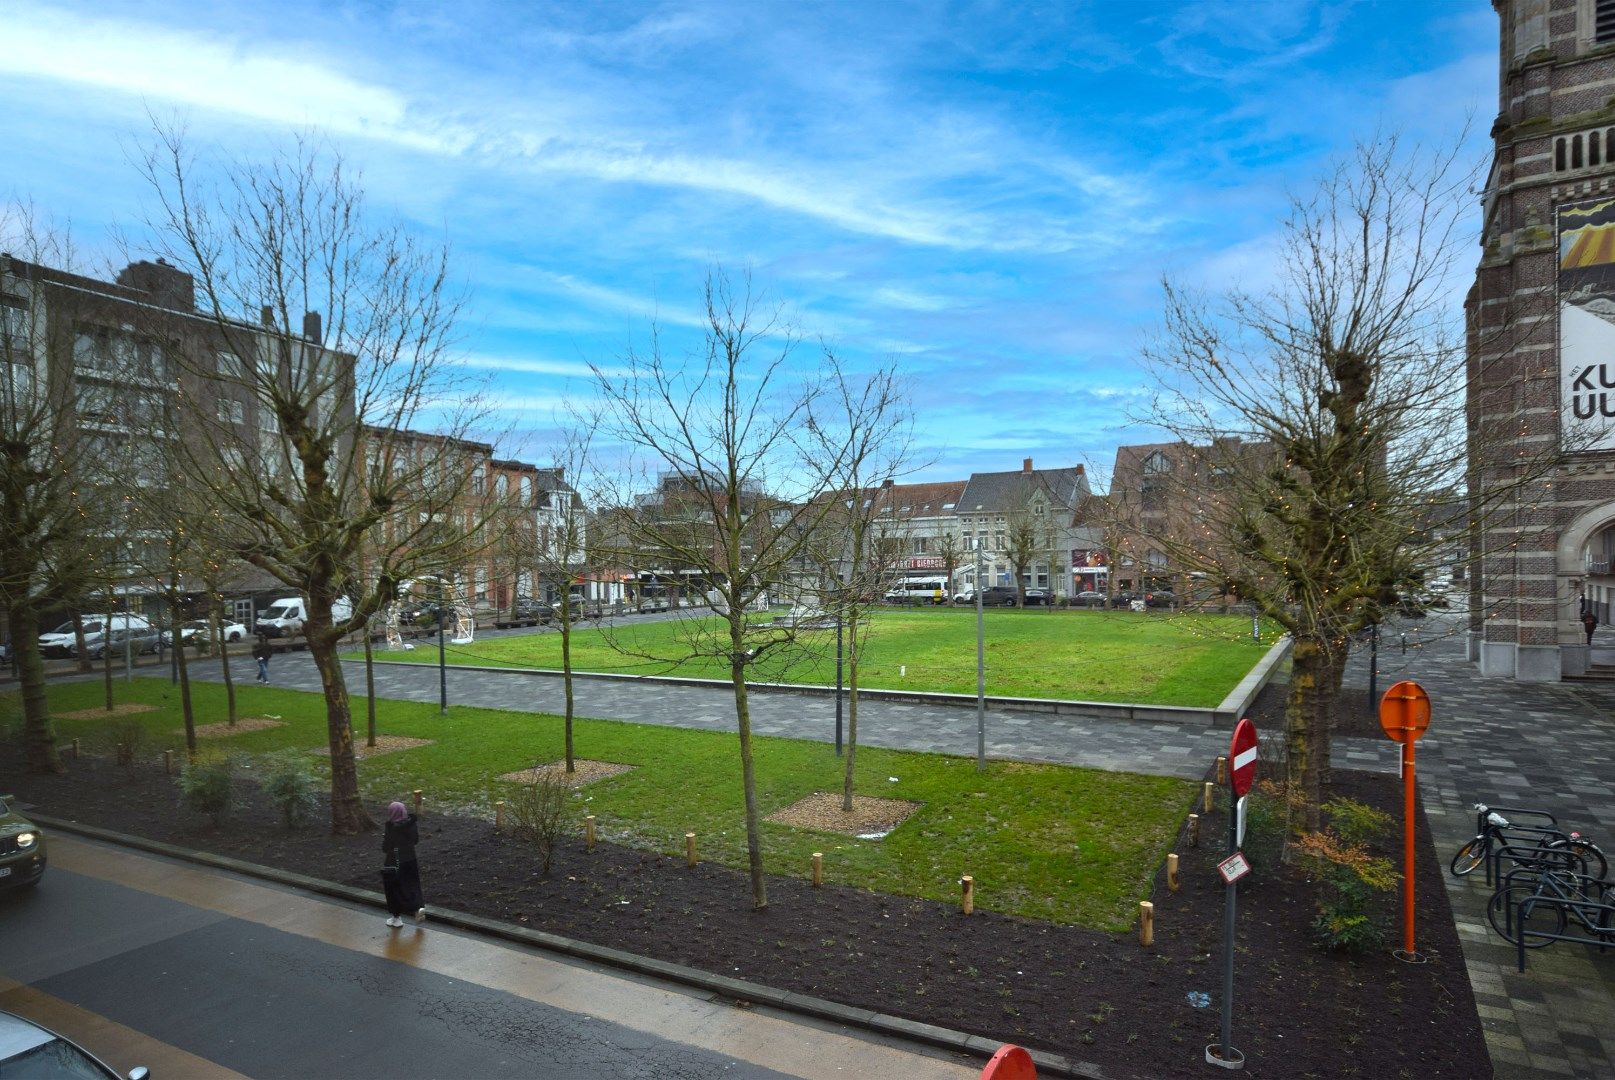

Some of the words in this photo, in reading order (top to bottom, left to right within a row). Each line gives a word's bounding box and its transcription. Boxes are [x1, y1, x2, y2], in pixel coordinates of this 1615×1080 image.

[1569, 365, 1581, 377] HET
[1573, 364, 1615, 391] KU
[1573, 393, 1615, 419] UU
